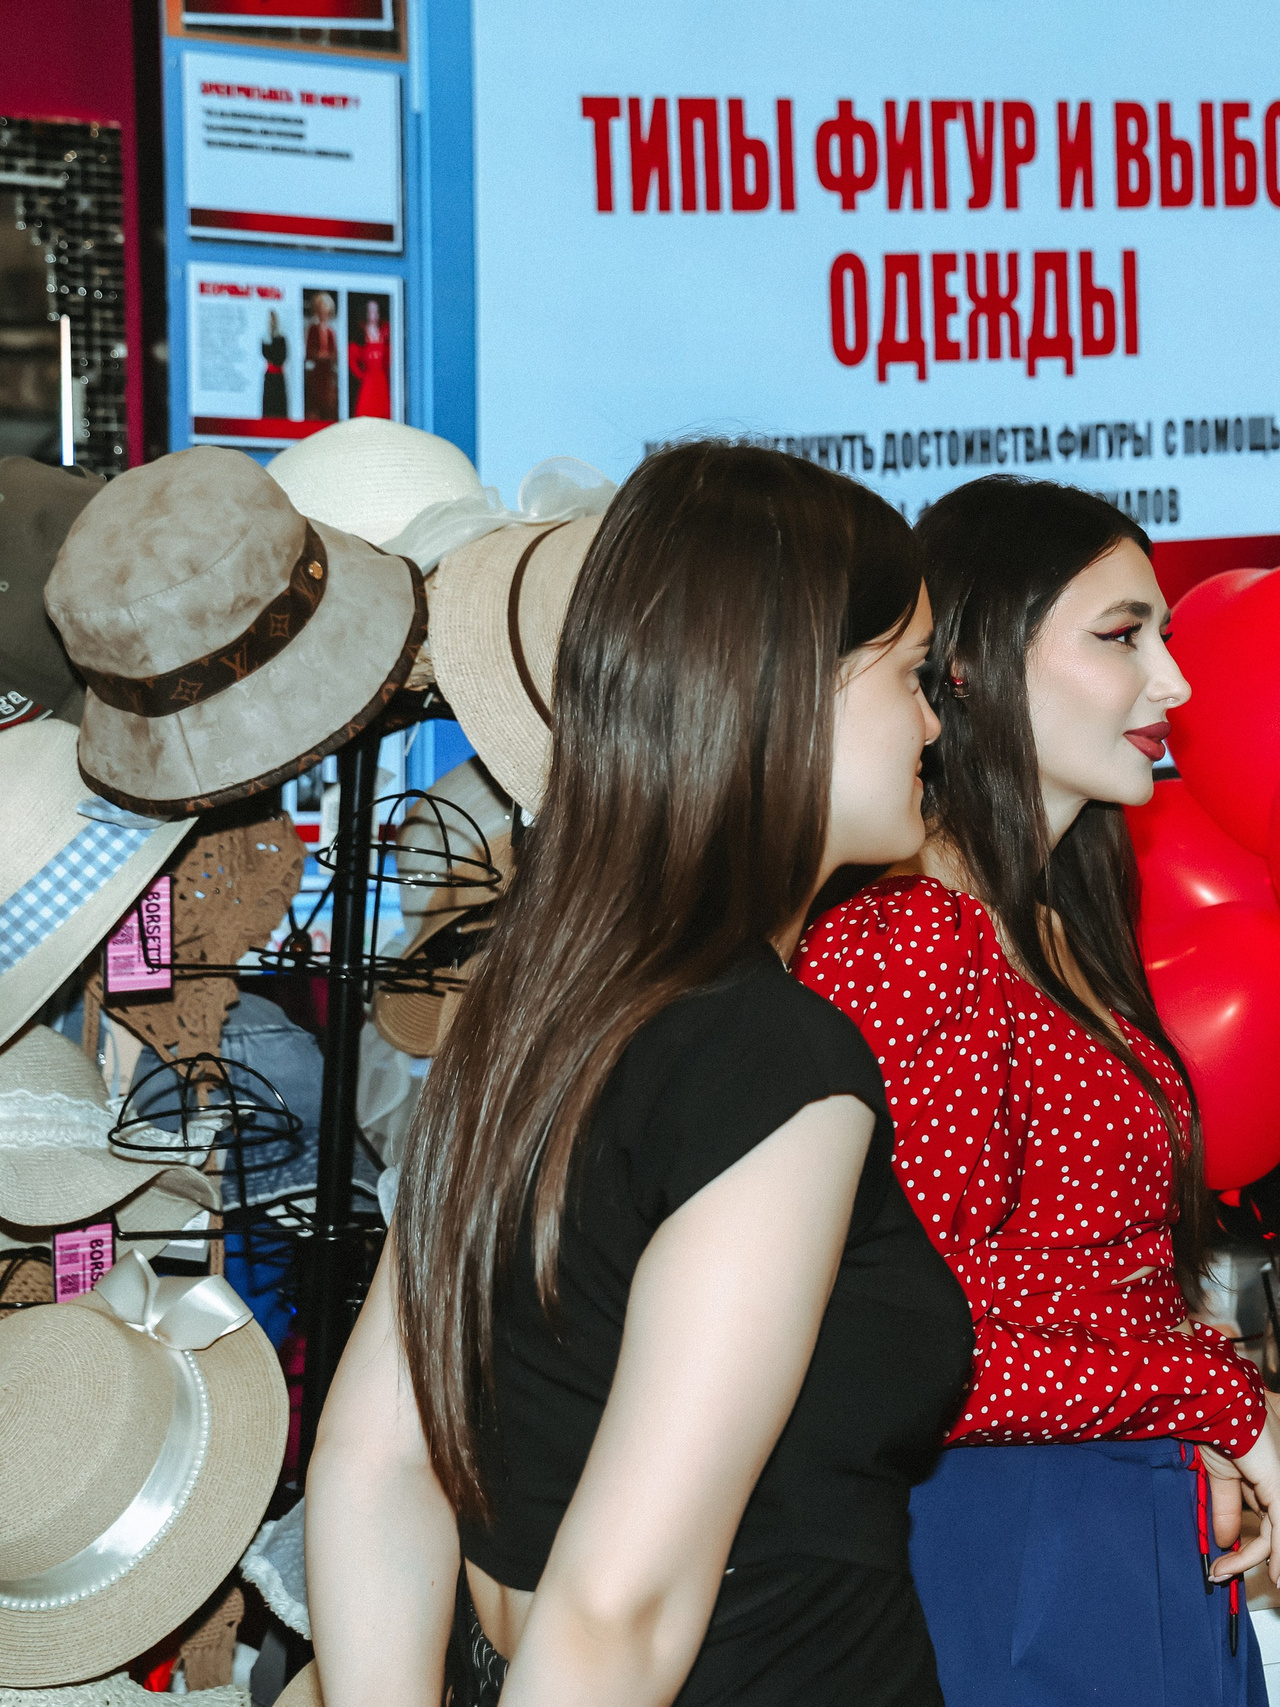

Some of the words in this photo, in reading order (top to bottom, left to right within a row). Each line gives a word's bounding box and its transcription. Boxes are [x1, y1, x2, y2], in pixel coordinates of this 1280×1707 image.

[582, 96, 796, 213] ТИПЫ
[815, 99, 1037, 211] ФИГУР
[1057, 100, 1095, 210] И
[829, 249, 1139, 383] ОДЕЖДЫ
[881, 425, 1053, 472] ДОСТОИНСТВА
[1056, 421, 1153, 461] ФИГУРЫ
[1164, 420, 1178, 457] С
[89, 1238, 105, 1292] BORS
